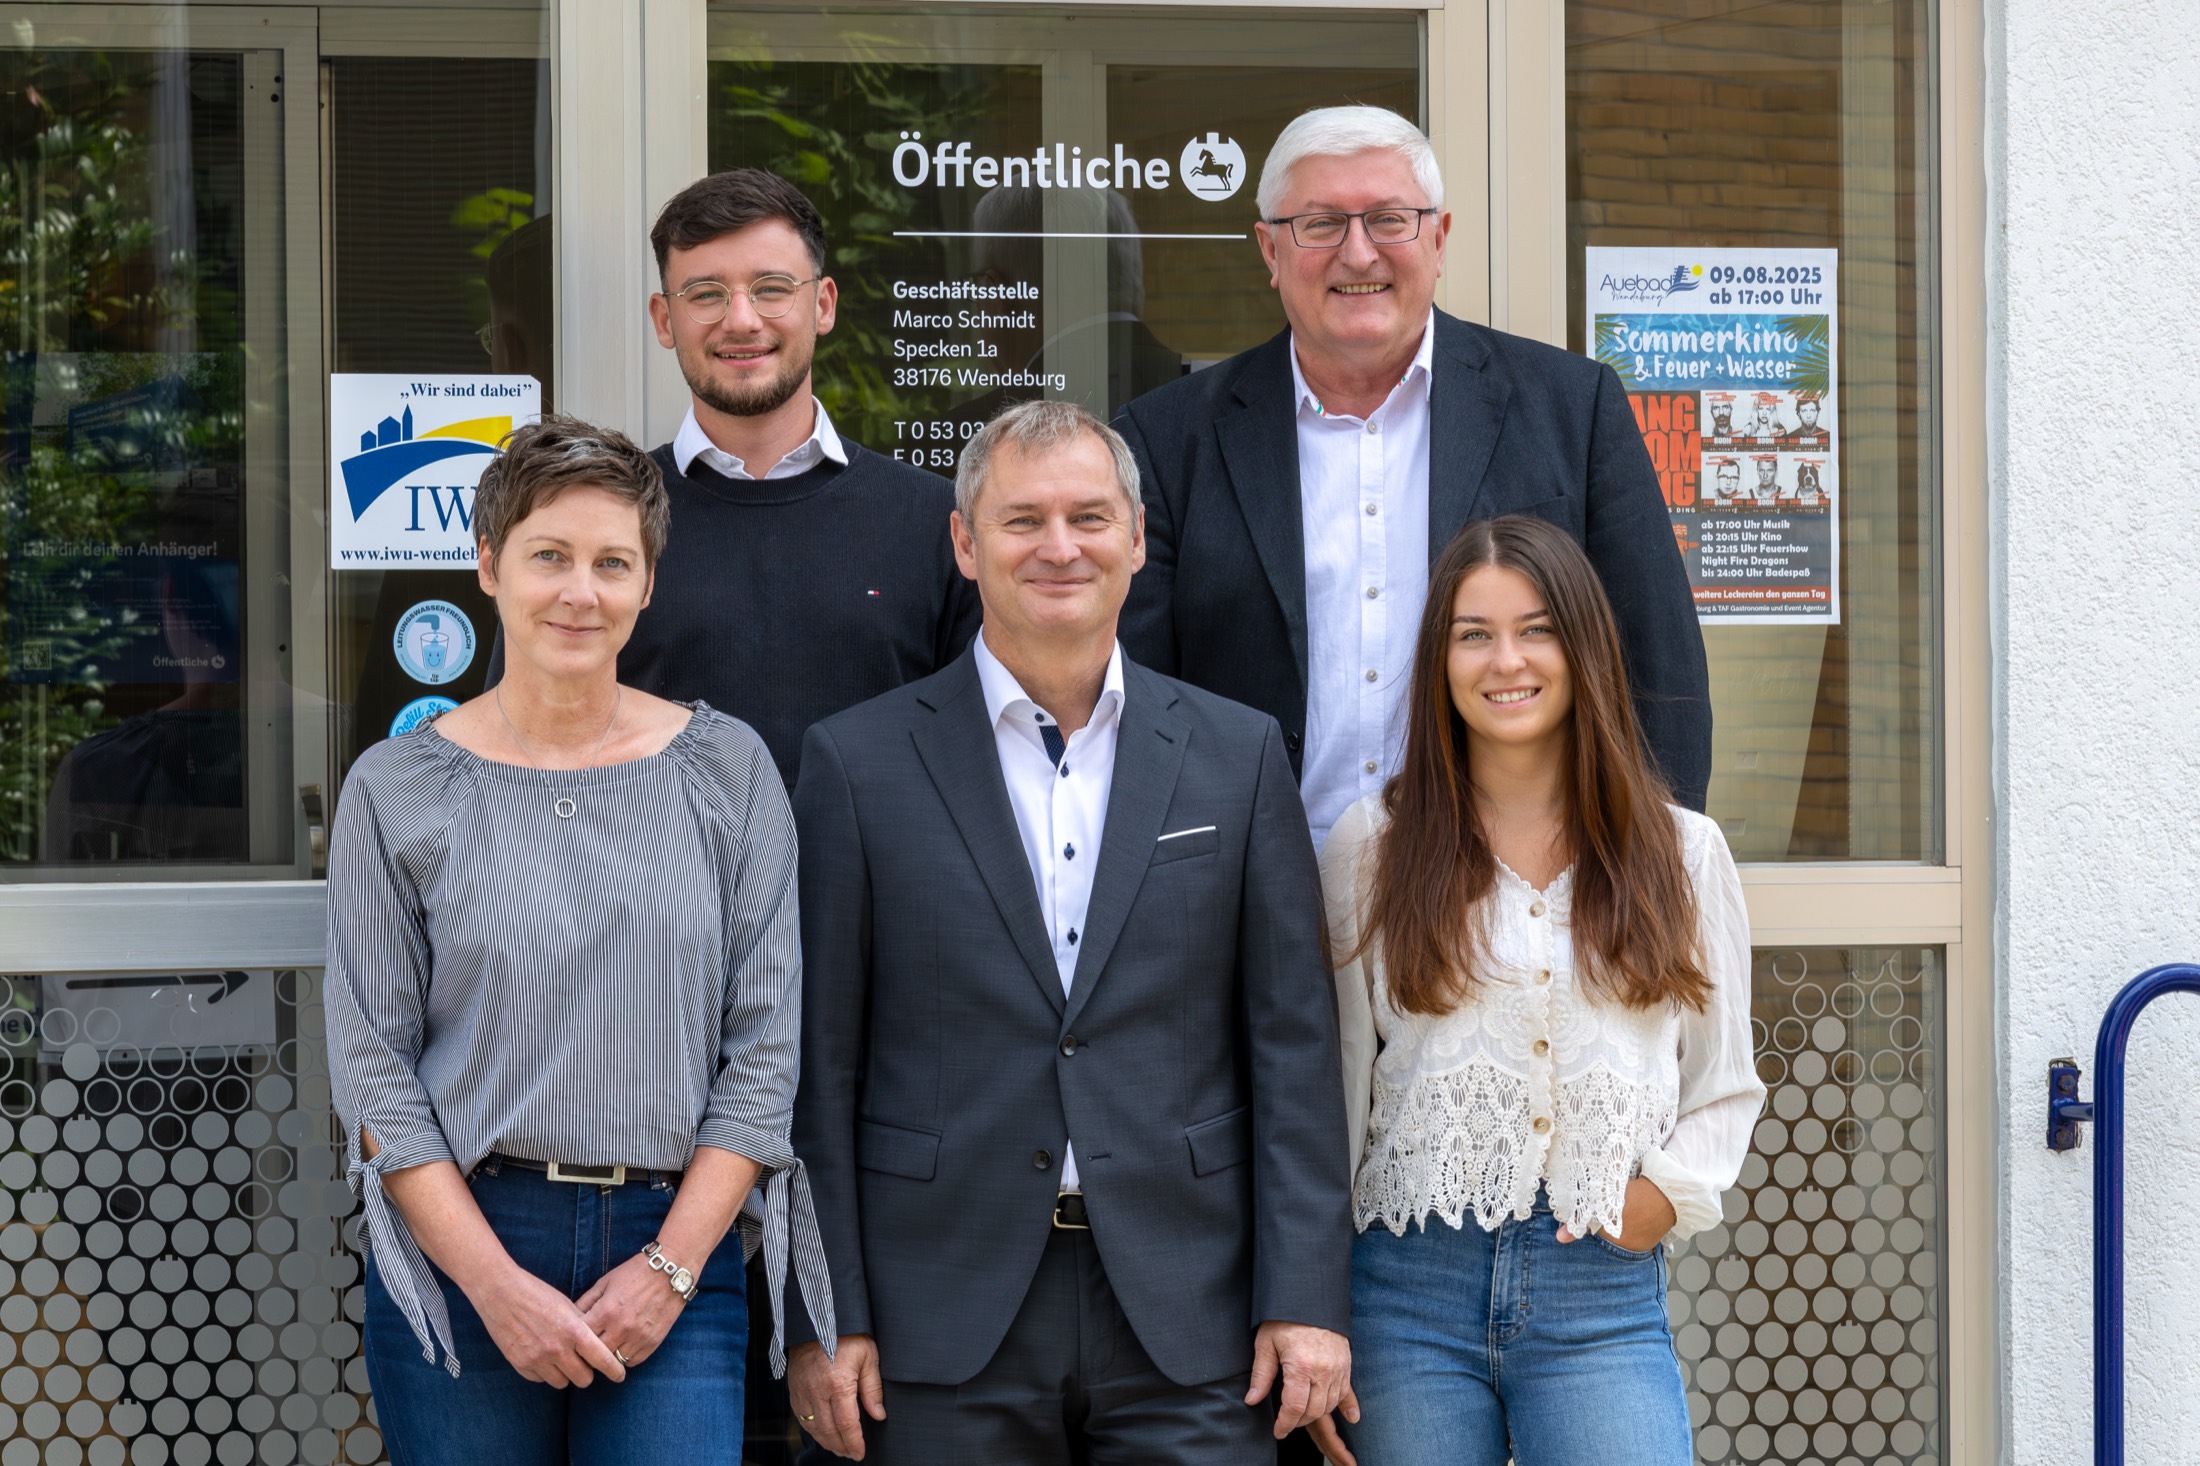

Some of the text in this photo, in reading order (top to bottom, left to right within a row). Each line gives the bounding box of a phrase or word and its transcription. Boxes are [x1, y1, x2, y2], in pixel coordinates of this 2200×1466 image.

[892, 131, 1170, 190] Öffentliche
[1600, 273, 1674, 292] Auebad
[1710, 266, 1822, 284] 09.08.2025
[893, 281, 1039, 299] Geschäftsstelle
[1710, 288, 1822, 305] ab 17:00 Uhr
[893, 310, 1035, 328] Marco Schmidt
[1613, 321, 1798, 354] Sommerkino
[894, 339, 997, 361] Specken 1a
[1654, 355, 1711, 378] Feuer
[1727, 354, 1796, 380] Wasser
[894, 368, 1066, 391] 38176 Wendeburg
[444, 384, 475, 397] sind
[894, 421, 906, 439] T
[911, 421, 924, 439] 0
[930, 421, 954, 439] 53
[912, 449, 924, 466] 0
[930, 449, 954, 466] 53
[1701, 520, 1790, 529] ab 17:00 Uhr Musik
[1701, 532, 1782, 541] ab 20:15 Uhr Kino
[59, 541, 77, 557] dir
[83, 541, 134, 557] deinen
[137, 541, 218, 560] Anhänger!
[1701, 544, 1809, 553] ab 22:15 Uhr Feuershow
[1702, 556, 1788, 567] Night Fire Dragons
[1702, 568, 1810, 579] bis 24:00 Uhr Badespaß
[1723, 590, 1763, 599] Leckereien
[1766, 590, 1780, 598] den
[1782, 591, 1809, 600] ganzen
[1811, 589, 1826, 600] Tag
[1730, 604, 1769, 612] Gastronomie
[1802, 605, 1826, 613] Agentur
[152, 655, 209, 668] Öffentliche
